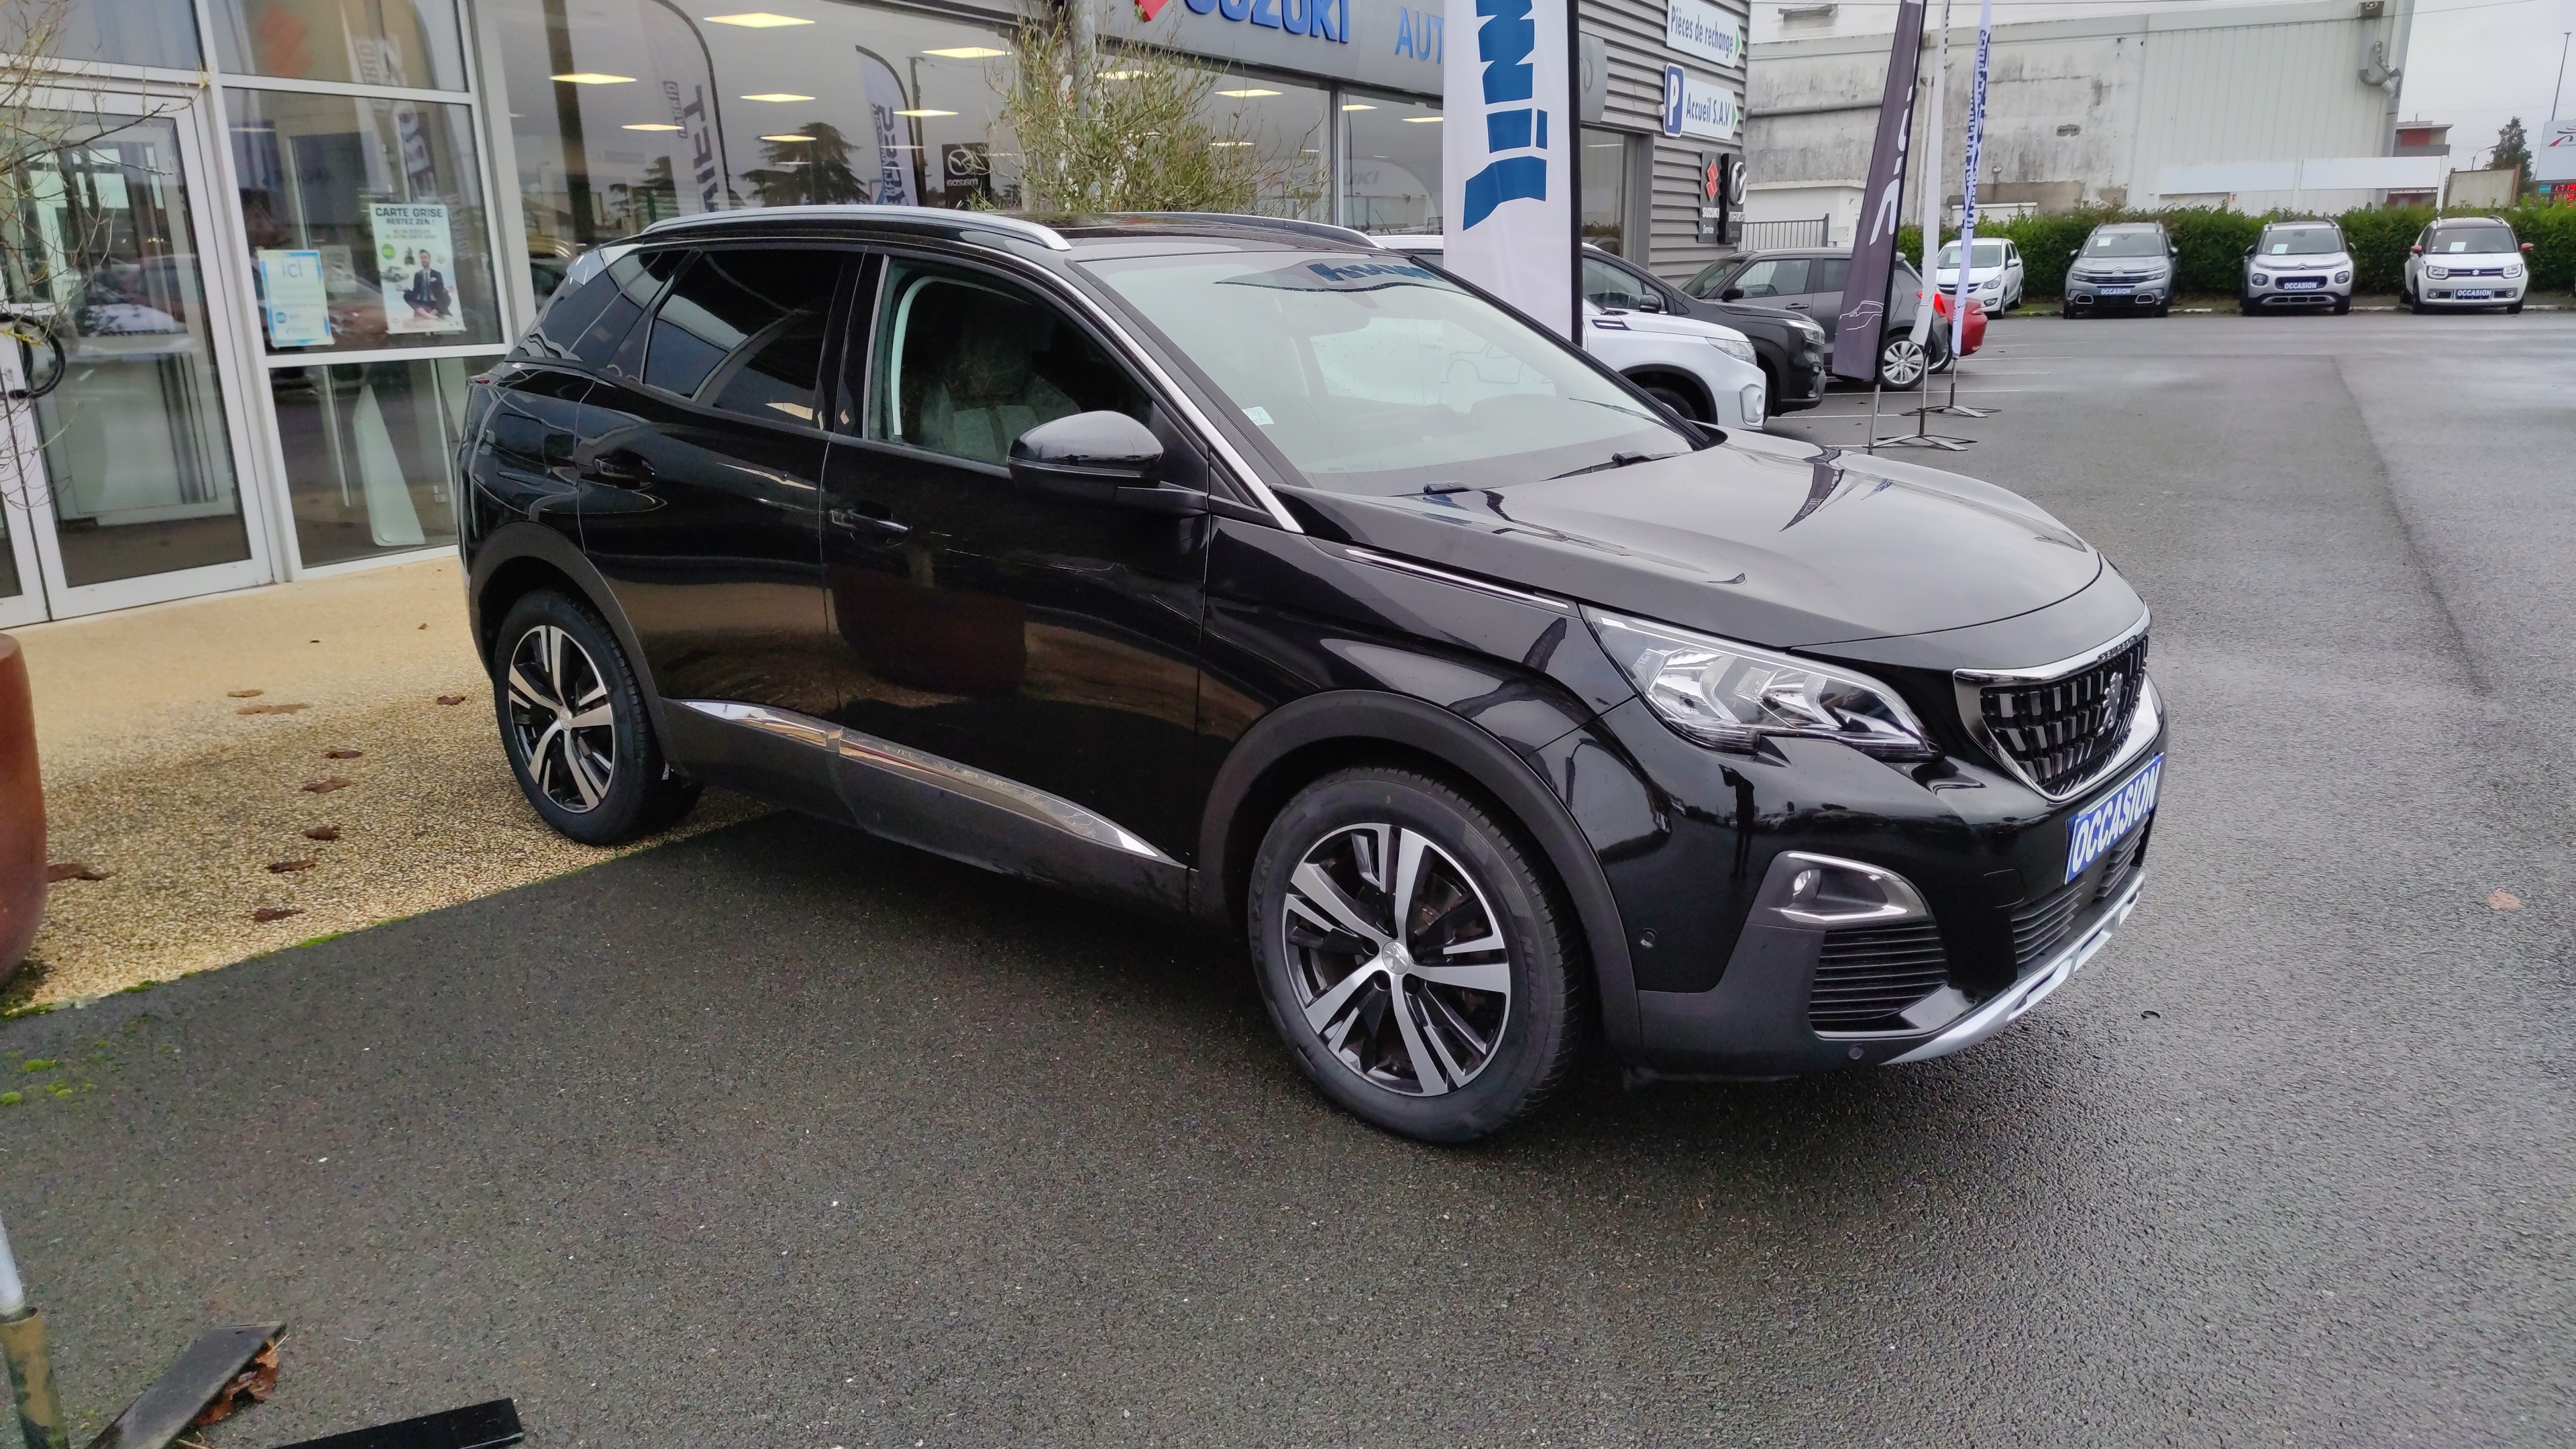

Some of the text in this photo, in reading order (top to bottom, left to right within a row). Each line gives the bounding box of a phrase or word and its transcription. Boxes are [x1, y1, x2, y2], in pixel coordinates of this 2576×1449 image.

[1394, 7, 1444, 64] AUT
[1670, 5, 1734, 59] Pièces de rechange
[1668, 73, 1680, 126] P
[1686, 92, 1711, 123] Accueil
[376, 207, 409, 217] CARTE
[1702, 207, 1720, 219] SUZUKI
[2072, 763, 2162, 873] OCCASION
